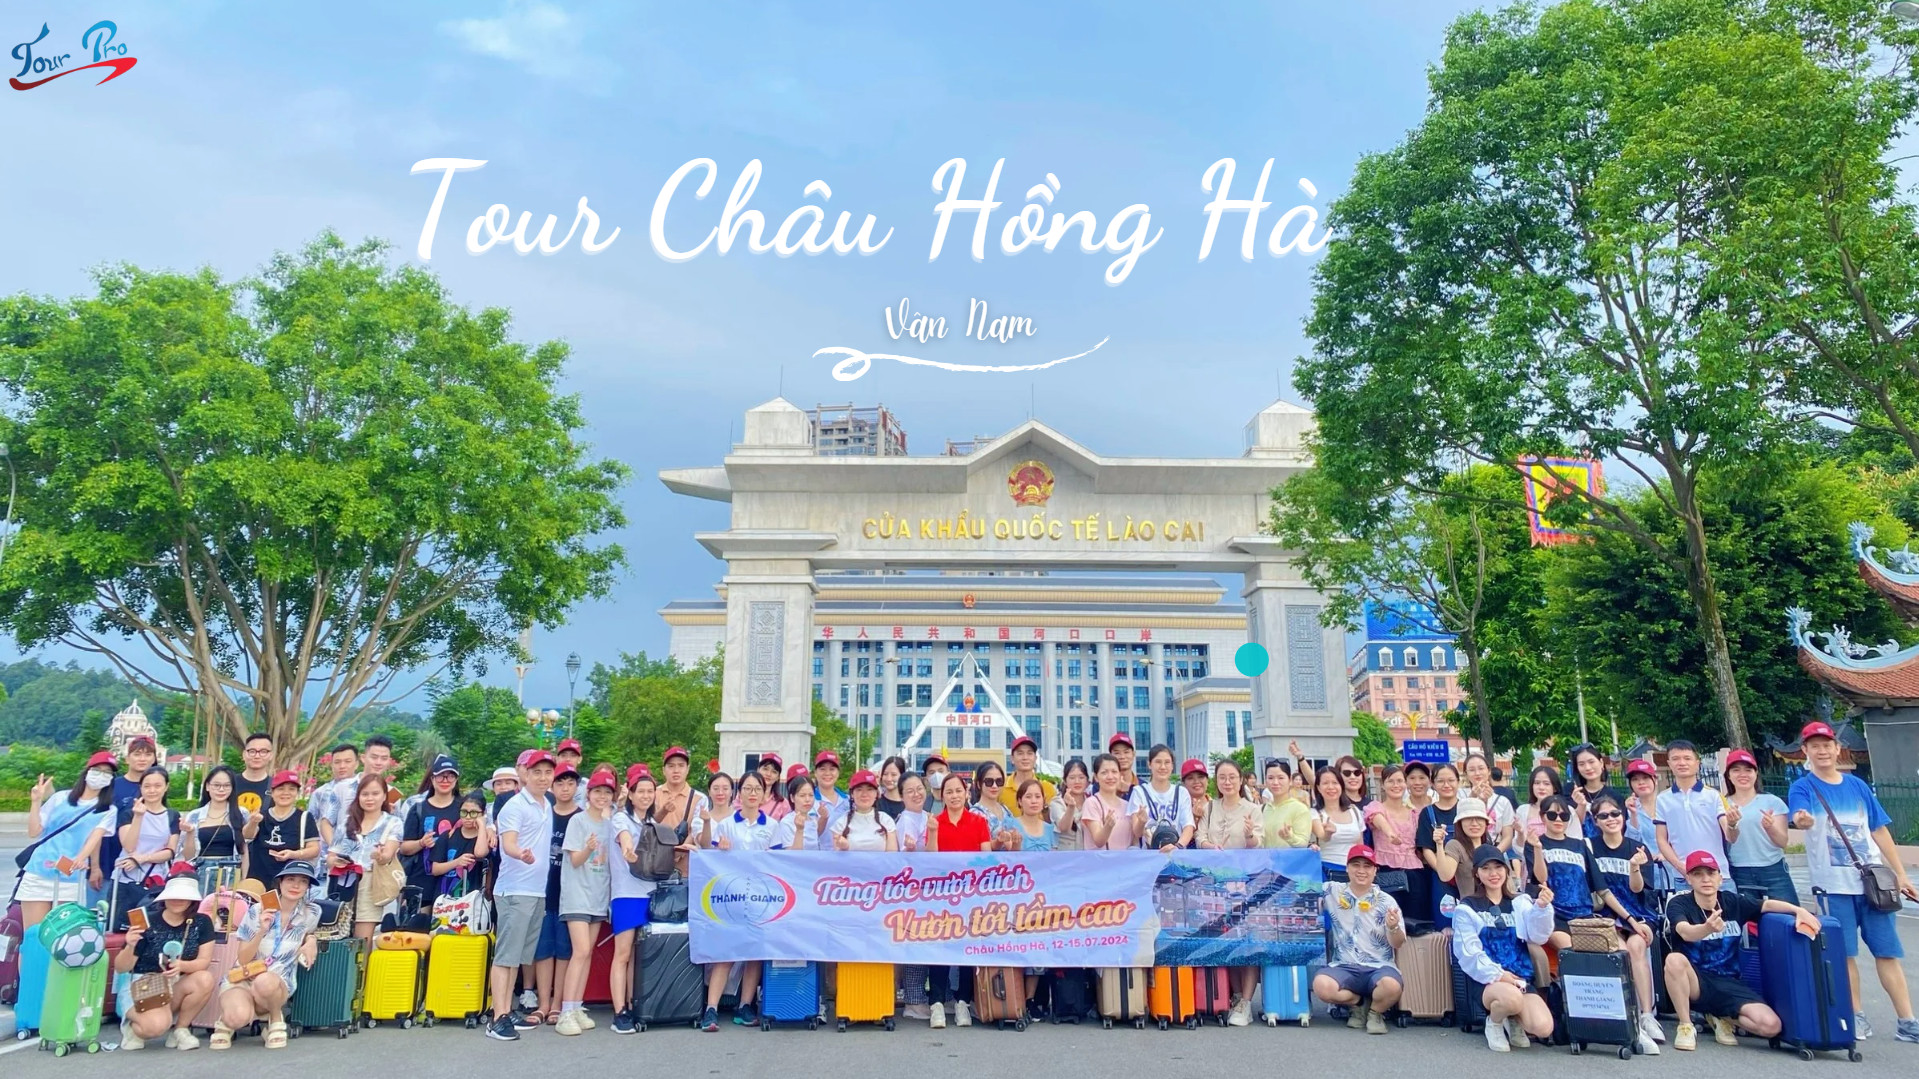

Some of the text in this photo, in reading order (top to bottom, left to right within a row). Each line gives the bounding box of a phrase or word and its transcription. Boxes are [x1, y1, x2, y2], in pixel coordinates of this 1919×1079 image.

[862, 508, 1205, 542] CỬA KHẨU QUỐC TẾ LÀO CAI
[822, 625, 1152, 642] 华人民共和国河口口岸
[945, 713, 992, 726] 中国河口
[710, 893, 785, 903] THANH GIANG
[813, 864, 1034, 911] Tăng tốc vượt đích
[884, 893, 1136, 942] Vươn tới tầm cao
[964, 943, 995, 956] Châu
[1029, 941, 1050, 952] Hà,
[1051, 935, 1129, 950] 12-15.07.2024
